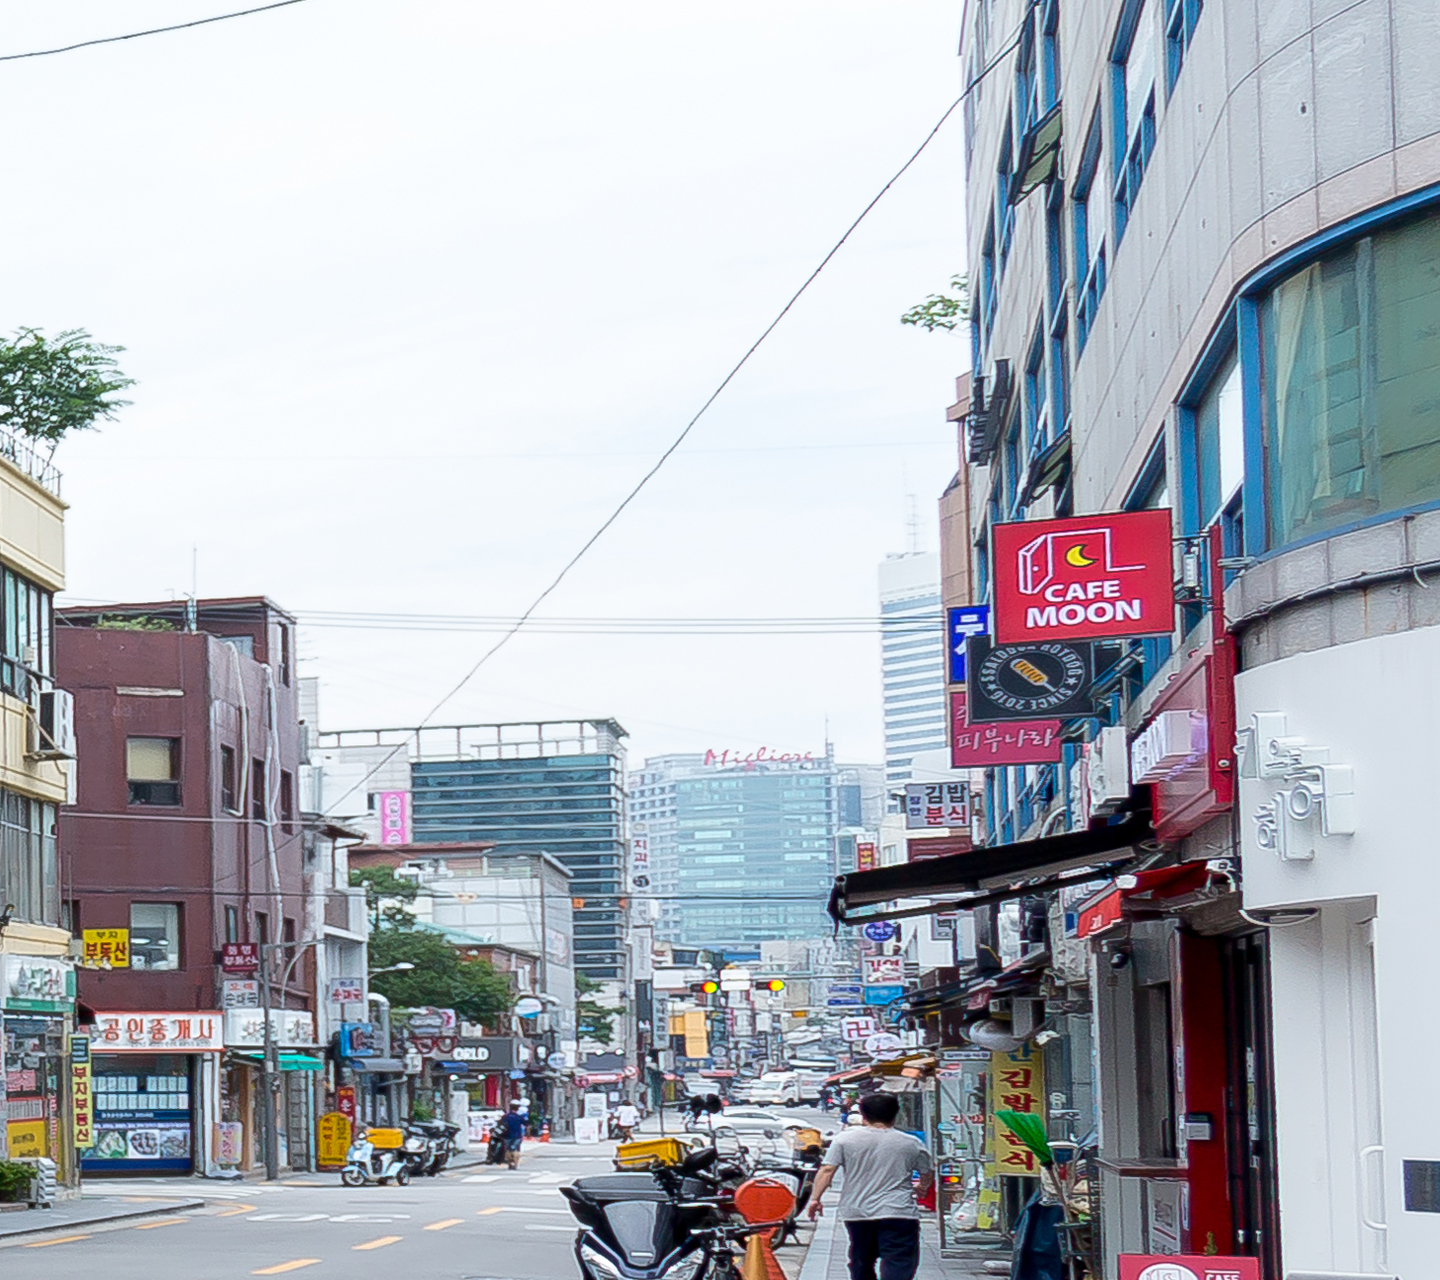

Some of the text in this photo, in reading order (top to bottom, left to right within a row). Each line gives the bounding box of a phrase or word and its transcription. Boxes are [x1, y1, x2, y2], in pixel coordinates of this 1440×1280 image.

[1044, 579, 1121, 603] CAFE
[1026, 599, 1142, 629] MOON
[956, 727, 1054, 752] 피부나라
[925, 784, 967, 804] 김밥
[925, 806, 967, 826] 분식
[85, 942, 128, 962] 부동산
[104, 1018, 215, 1042] 공인중개사
